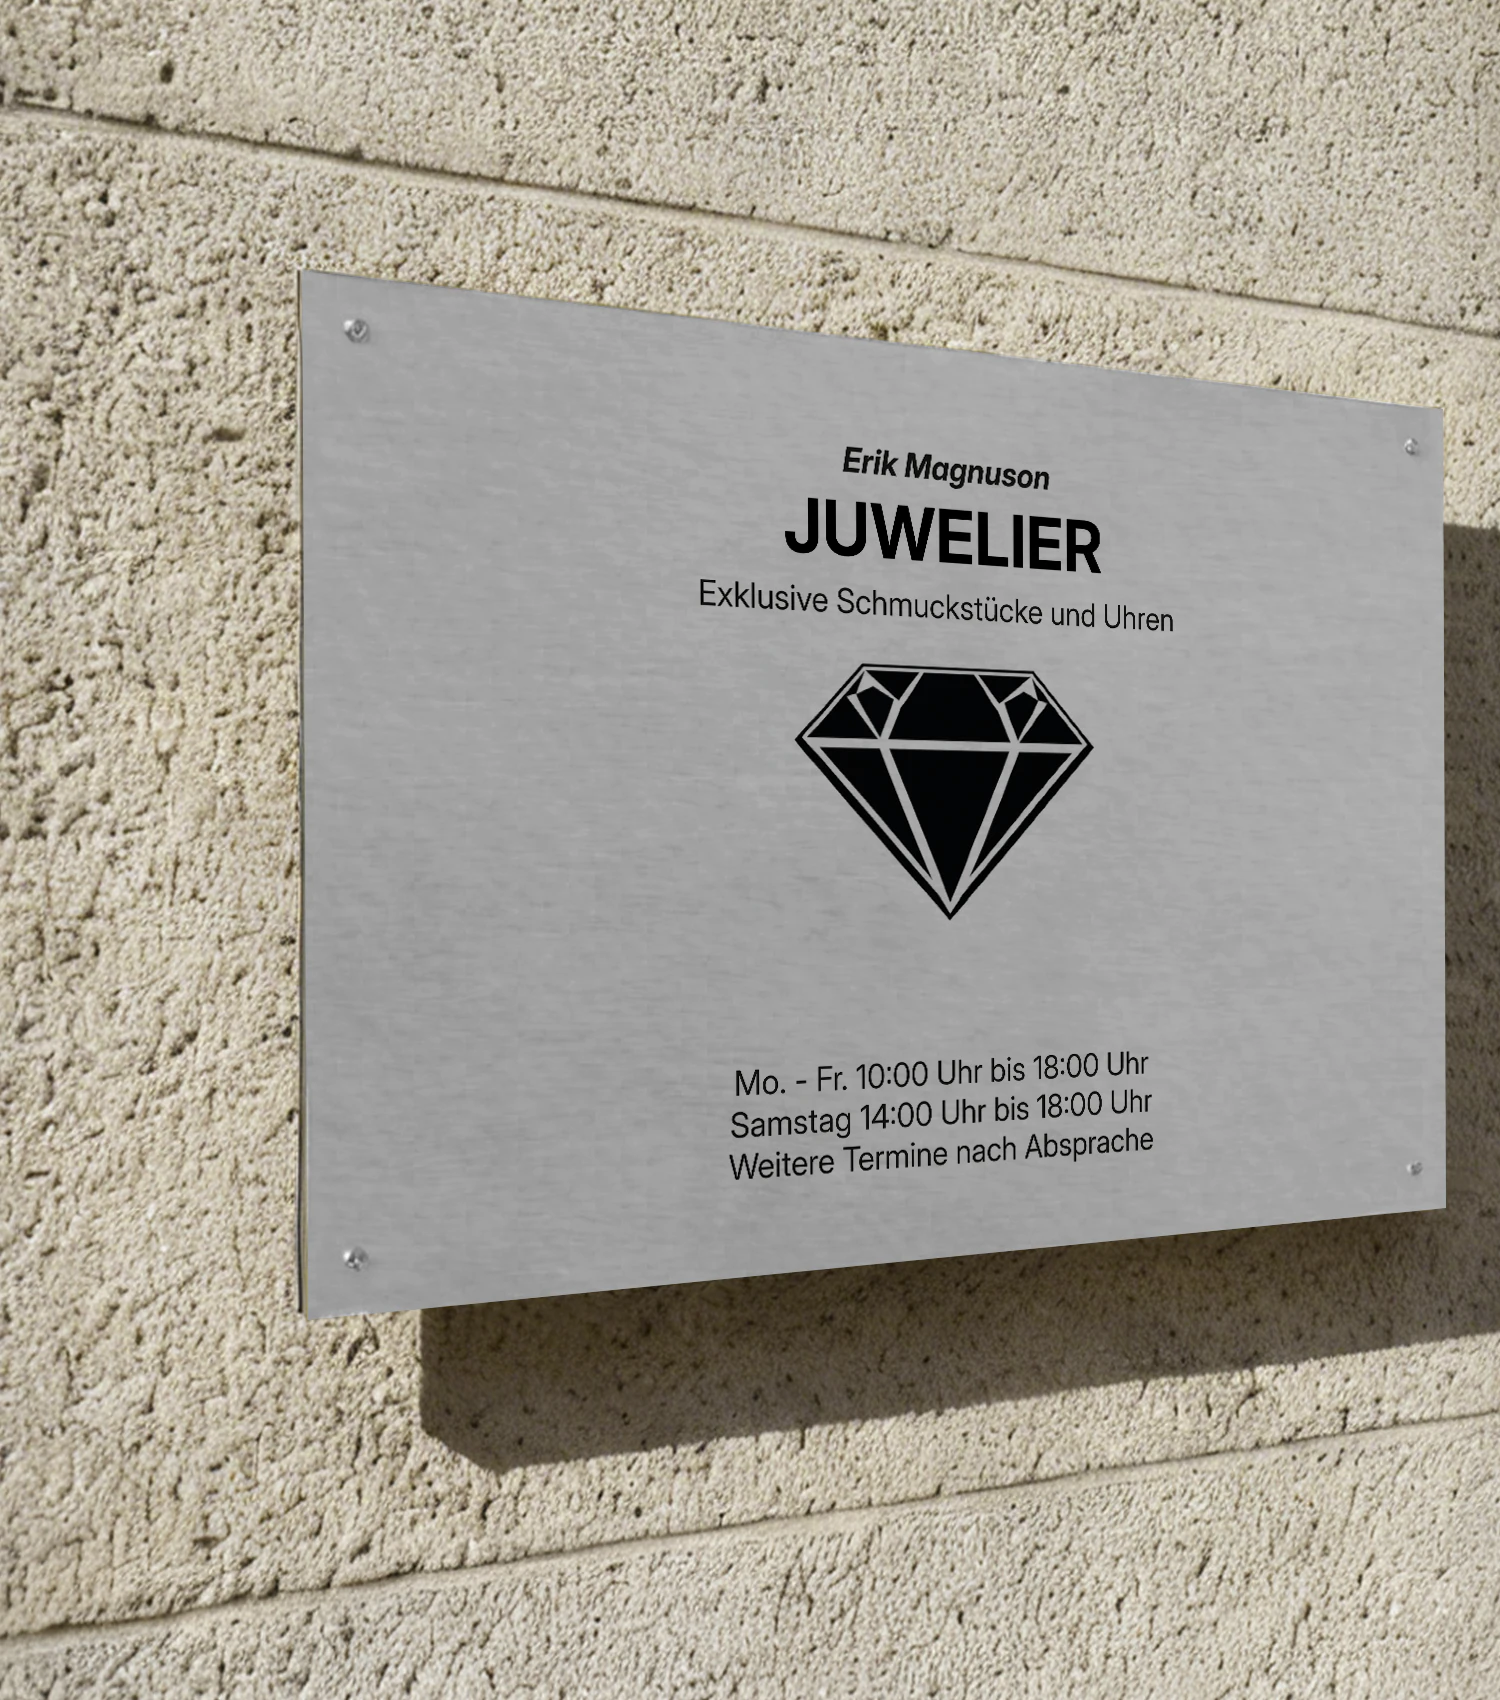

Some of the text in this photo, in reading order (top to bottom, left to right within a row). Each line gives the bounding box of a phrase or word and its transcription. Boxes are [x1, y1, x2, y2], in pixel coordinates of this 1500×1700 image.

[842, 446, 1050, 491] Erik Magnuson
[784, 497, 1102, 574] JUWELIER
[699, 578, 1174, 632] Exklusive Schmuckstücke und Uhren
[735, 1068, 786, 1097] Mo.
[817, 1065, 848, 1092] Fr.
[856, 1060, 929, 1090] 10:00
[937, 1059, 983, 1086] Uhr
[990, 1056, 1026, 1083] bis
[1033, 1052, 1099, 1080] 18:00
[1107, 1050, 1149, 1077] Uhr
[730, 1088, 1153, 1139] Samstag 14:00 Uhr bis 18:00 Uhr
[728, 1127, 1154, 1181] Weitere Termine nach Absprache
